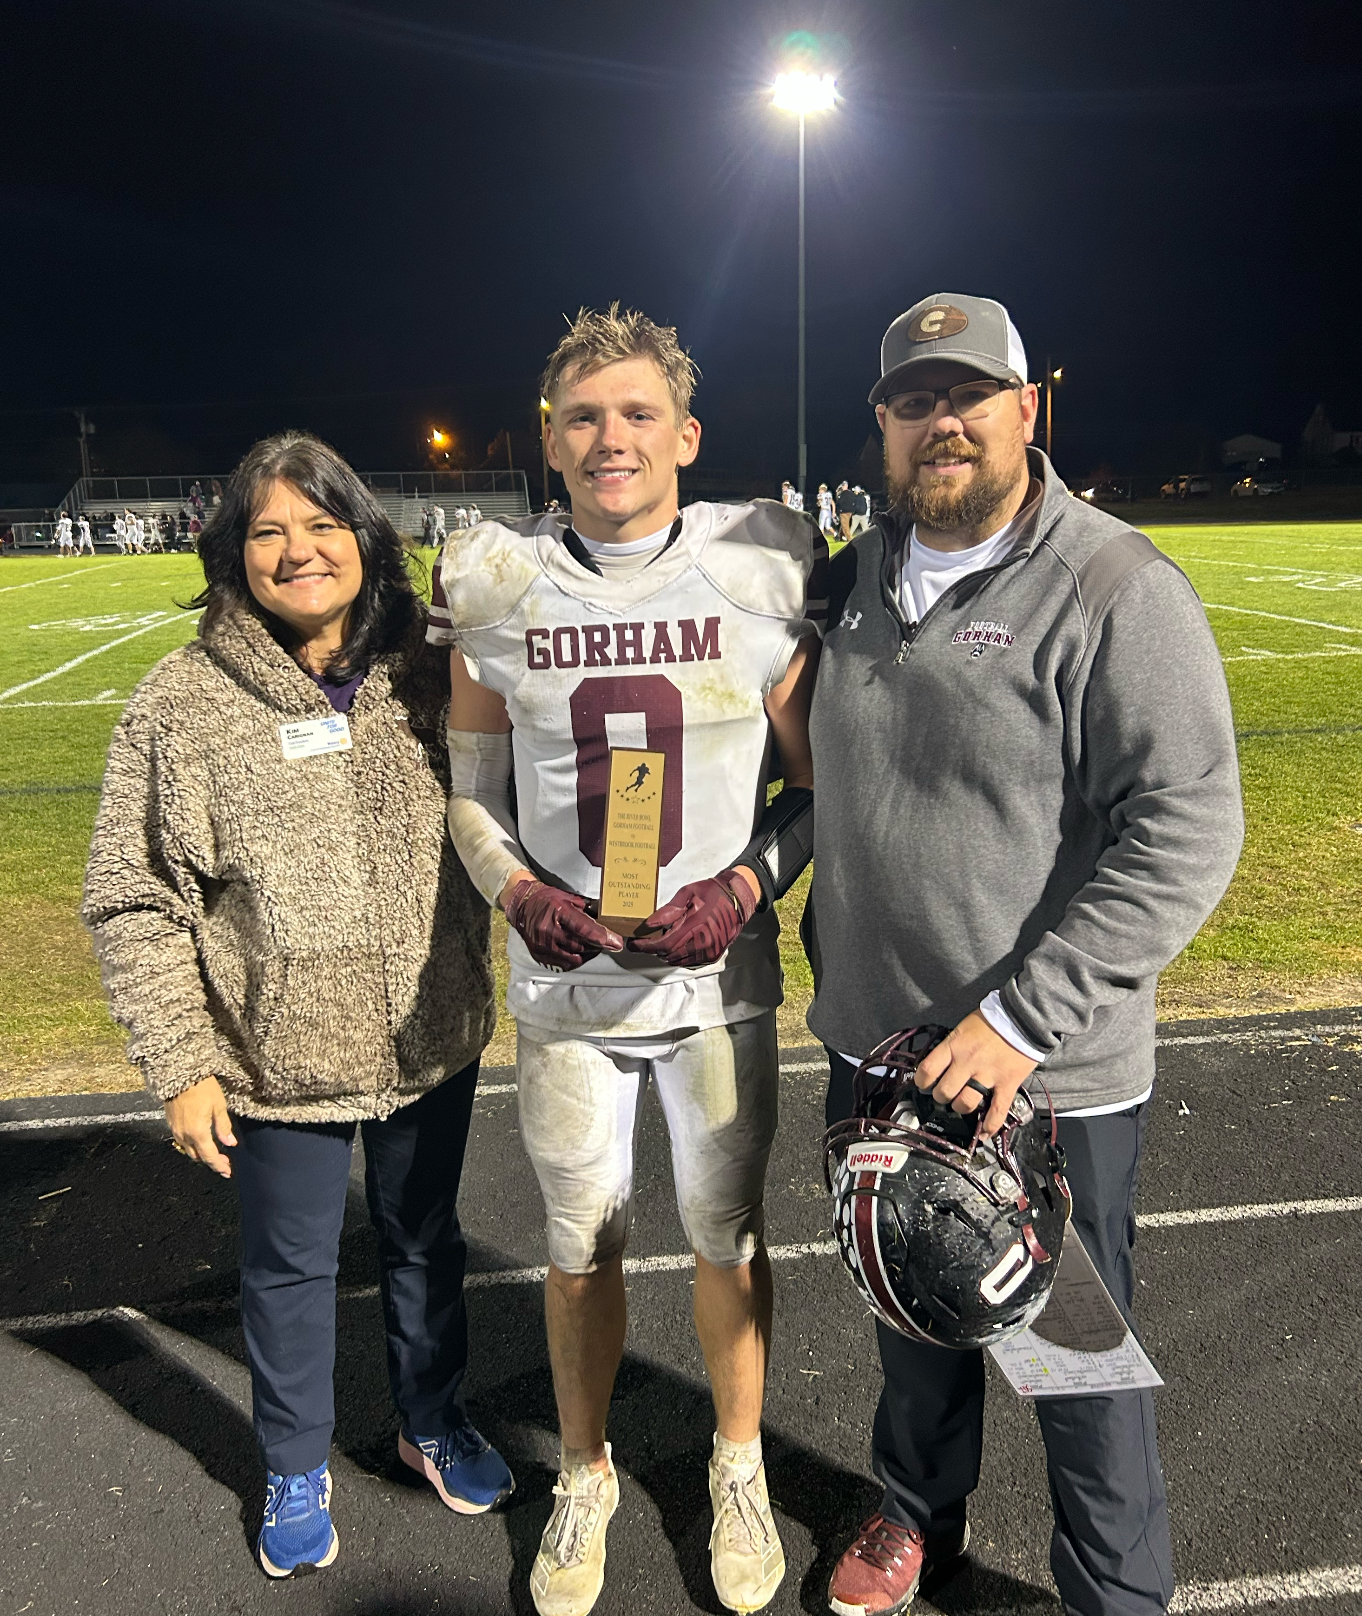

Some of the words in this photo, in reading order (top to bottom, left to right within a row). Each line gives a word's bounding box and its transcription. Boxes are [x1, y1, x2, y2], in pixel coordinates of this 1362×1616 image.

[524, 616, 722, 671] GORHAM
[951, 630, 1017, 648] GORHAM
[568, 673, 684, 868] 0
[608, 881, 650, 890] OUTSTANDING
[849, 1153, 893, 1168] Riddell
